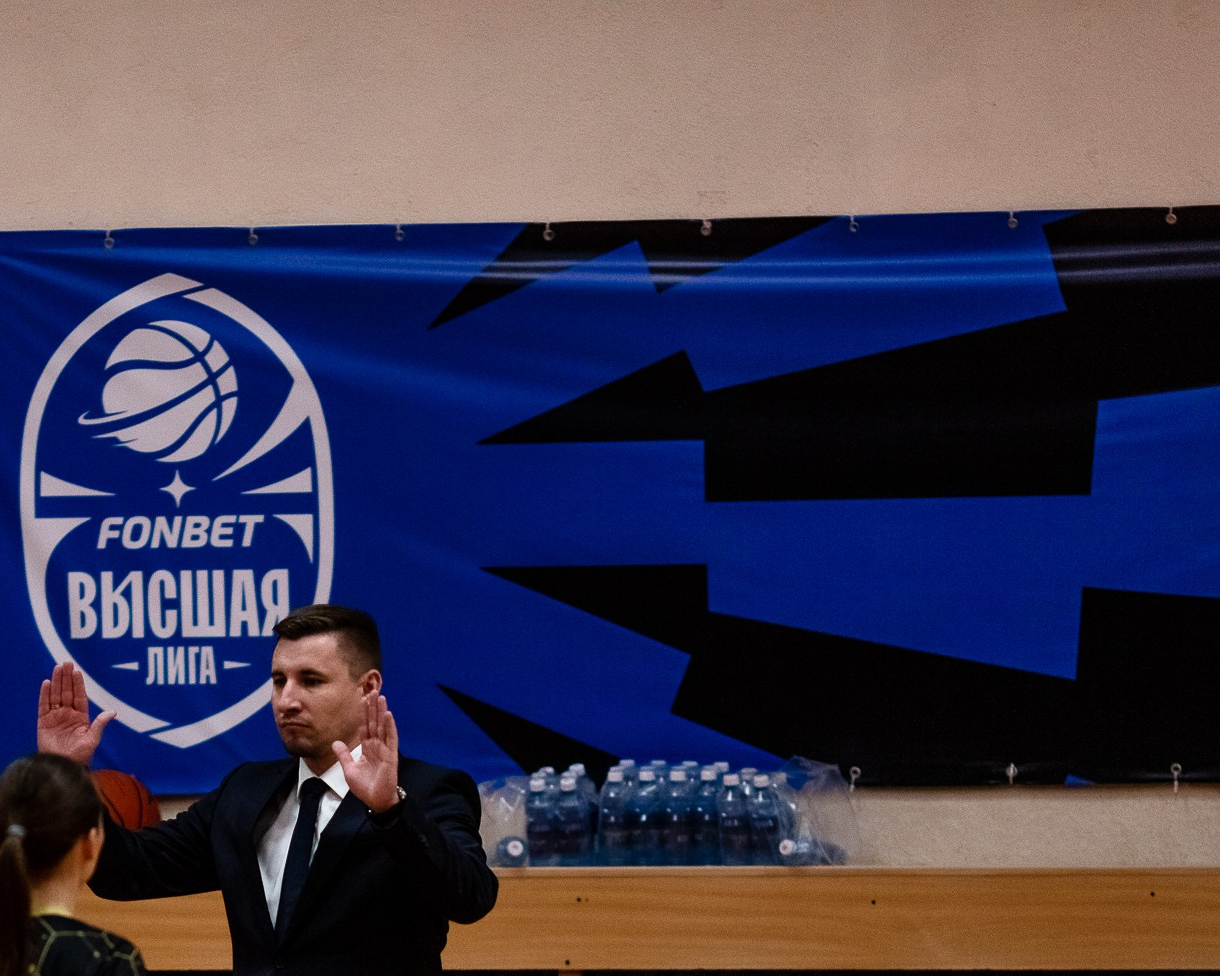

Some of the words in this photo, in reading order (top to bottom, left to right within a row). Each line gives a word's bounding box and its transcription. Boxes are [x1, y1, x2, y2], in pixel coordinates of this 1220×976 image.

[97, 515, 264, 549] FONBET
[67, 568, 290, 640] ВЫСШАЯ
[145, 646, 217, 685] ЛИГА
